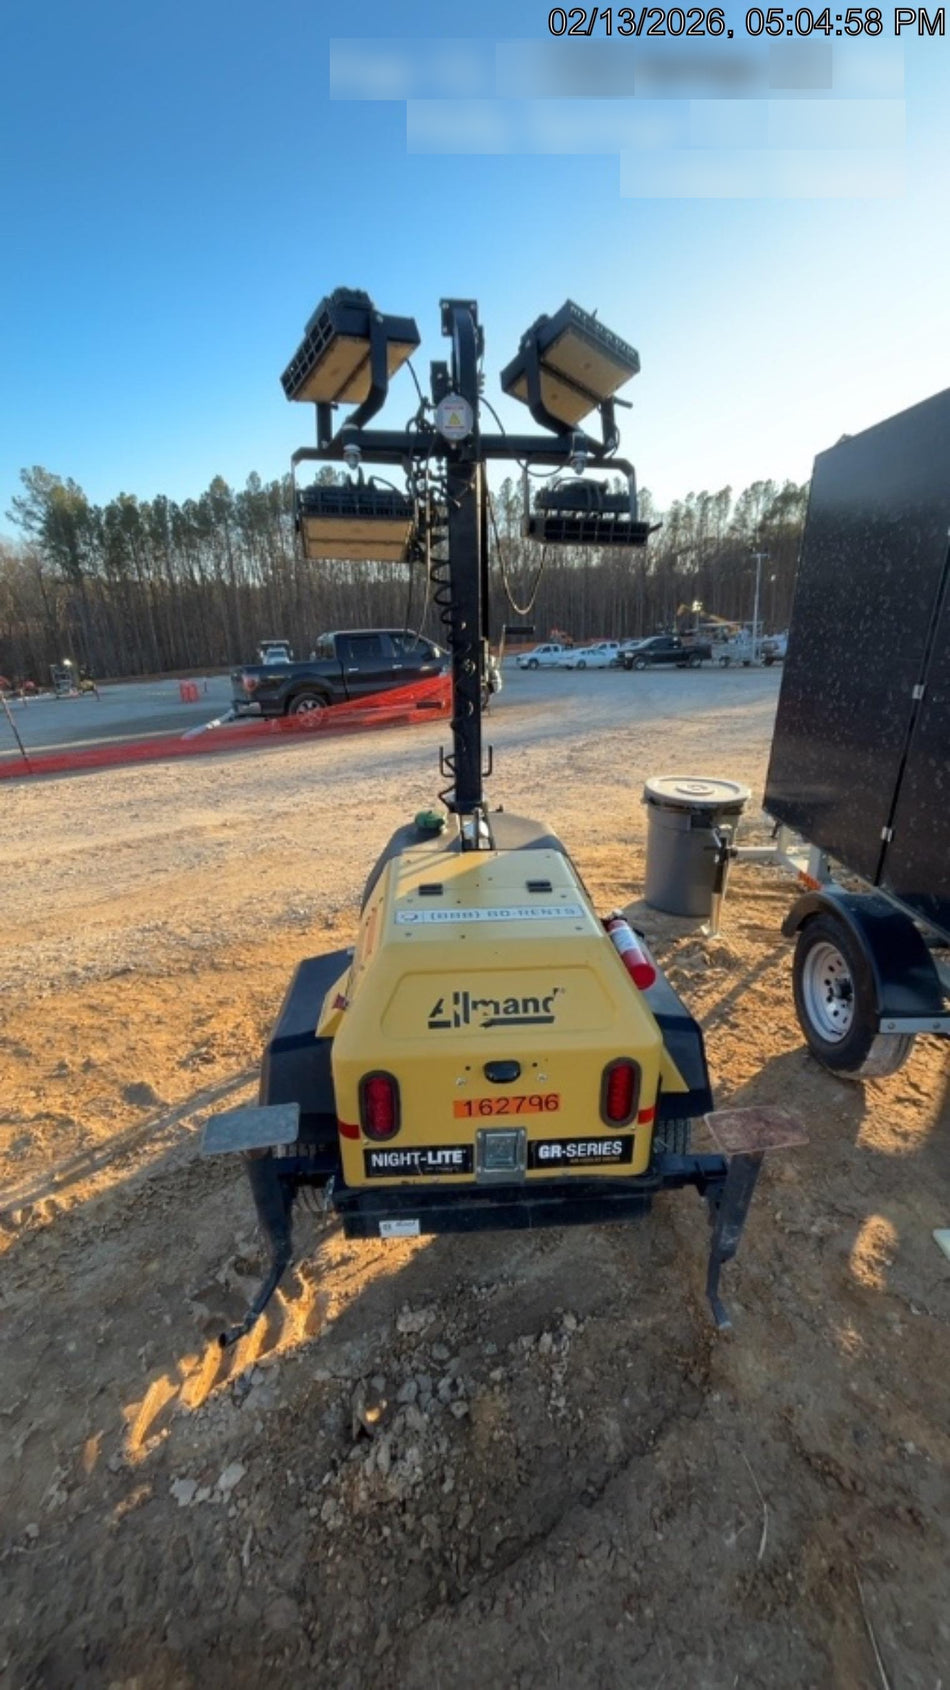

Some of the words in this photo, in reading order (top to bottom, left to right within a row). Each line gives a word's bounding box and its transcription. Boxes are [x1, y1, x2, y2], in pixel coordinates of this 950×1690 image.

[464, 1093, 559, 1117] 162796
[371, 1149, 463, 1167] NIGHT-LITE
[538, 1141, 622, 1159] GR-SERIES
